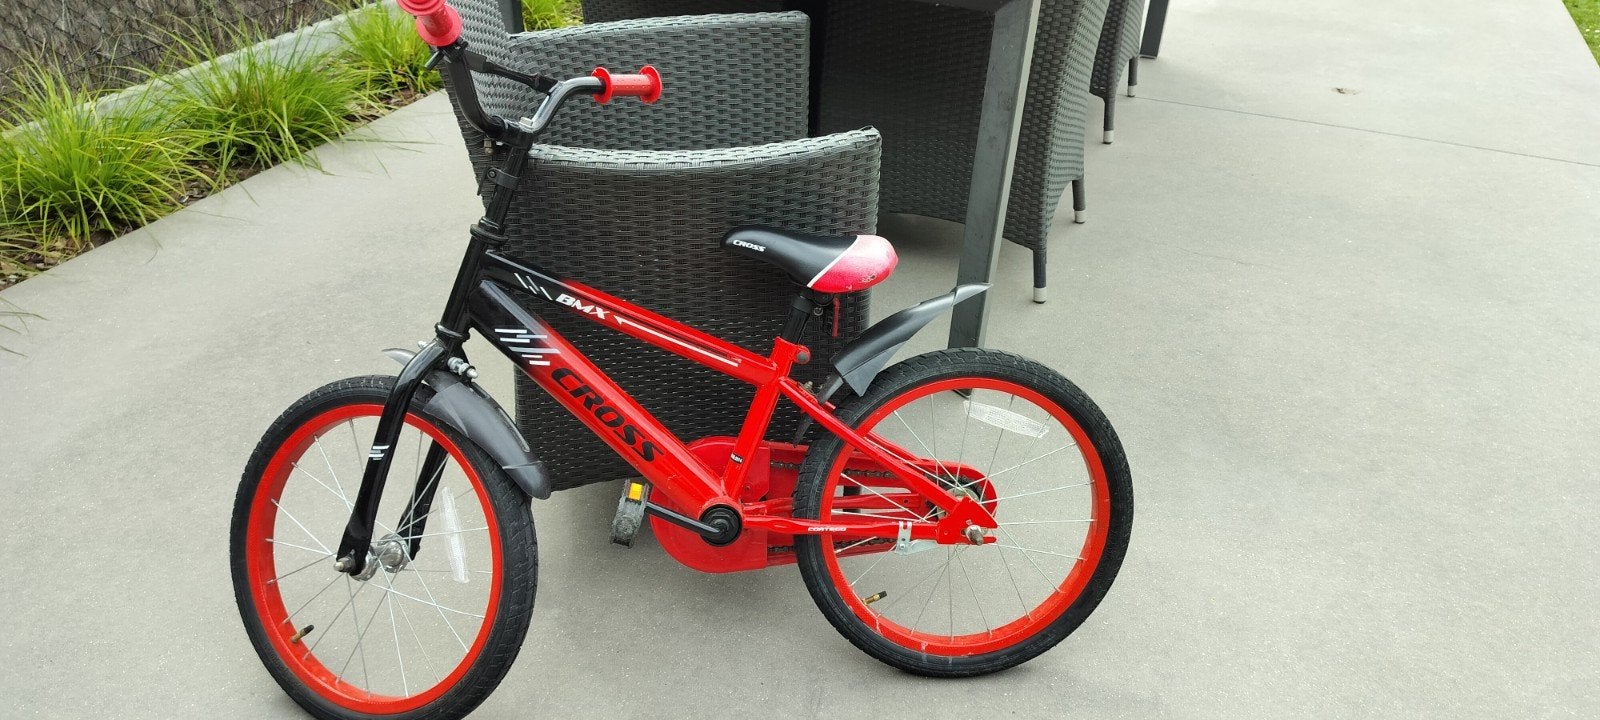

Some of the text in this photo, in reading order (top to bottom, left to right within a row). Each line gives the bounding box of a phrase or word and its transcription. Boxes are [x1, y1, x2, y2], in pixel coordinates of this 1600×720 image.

[733, 239, 766, 252] CROSS
[555, 293, 611, 319] BMX
[551, 367, 665, 462] CROSS
